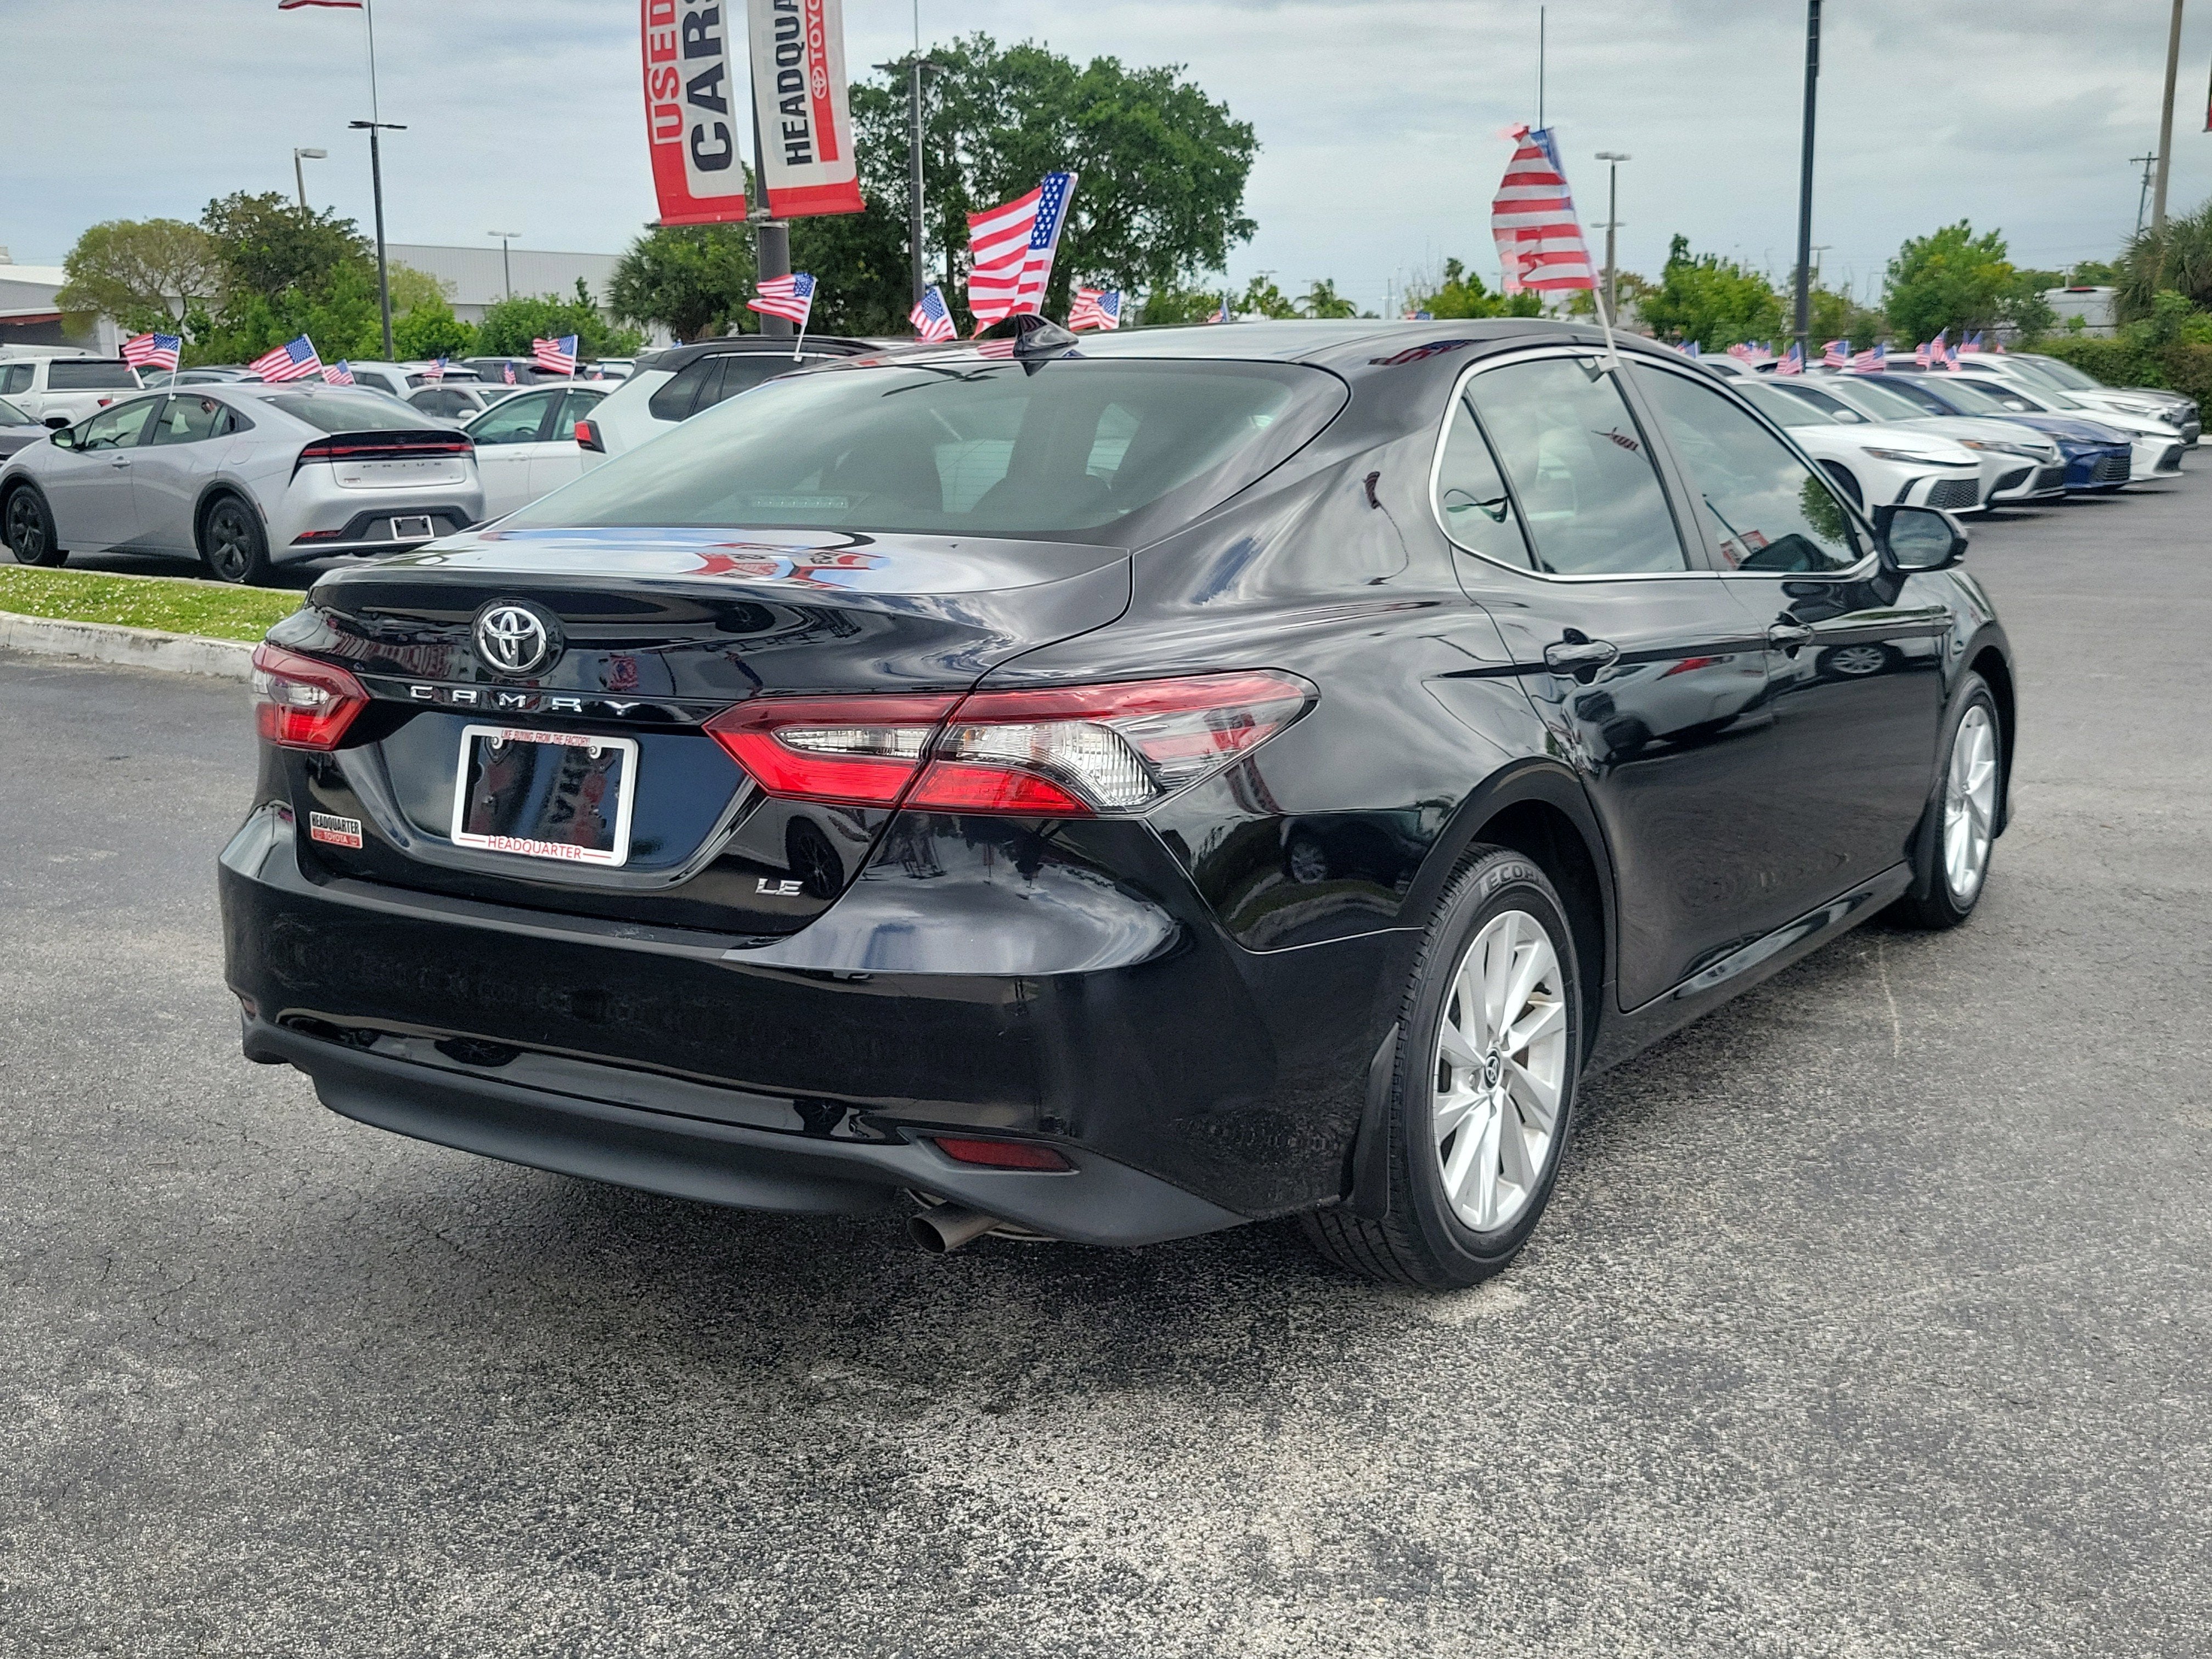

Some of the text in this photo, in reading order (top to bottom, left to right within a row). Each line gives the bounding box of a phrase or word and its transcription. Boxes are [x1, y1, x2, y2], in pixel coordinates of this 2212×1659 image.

[650, 0, 684, 140] USED
[682, 0, 732, 172] CAR
[410, 685, 641, 716] CAMRY
[501, 729, 512, 739] LIKE
[535, 732, 551, 743] FROM
[554, 734, 564, 744] THE
[311, 814, 360, 834] HEADQUARTER
[324, 831, 349, 844] TOYOTA
[487, 834, 582, 859] HEADQUARTER
[755, 878, 804, 896] LE
